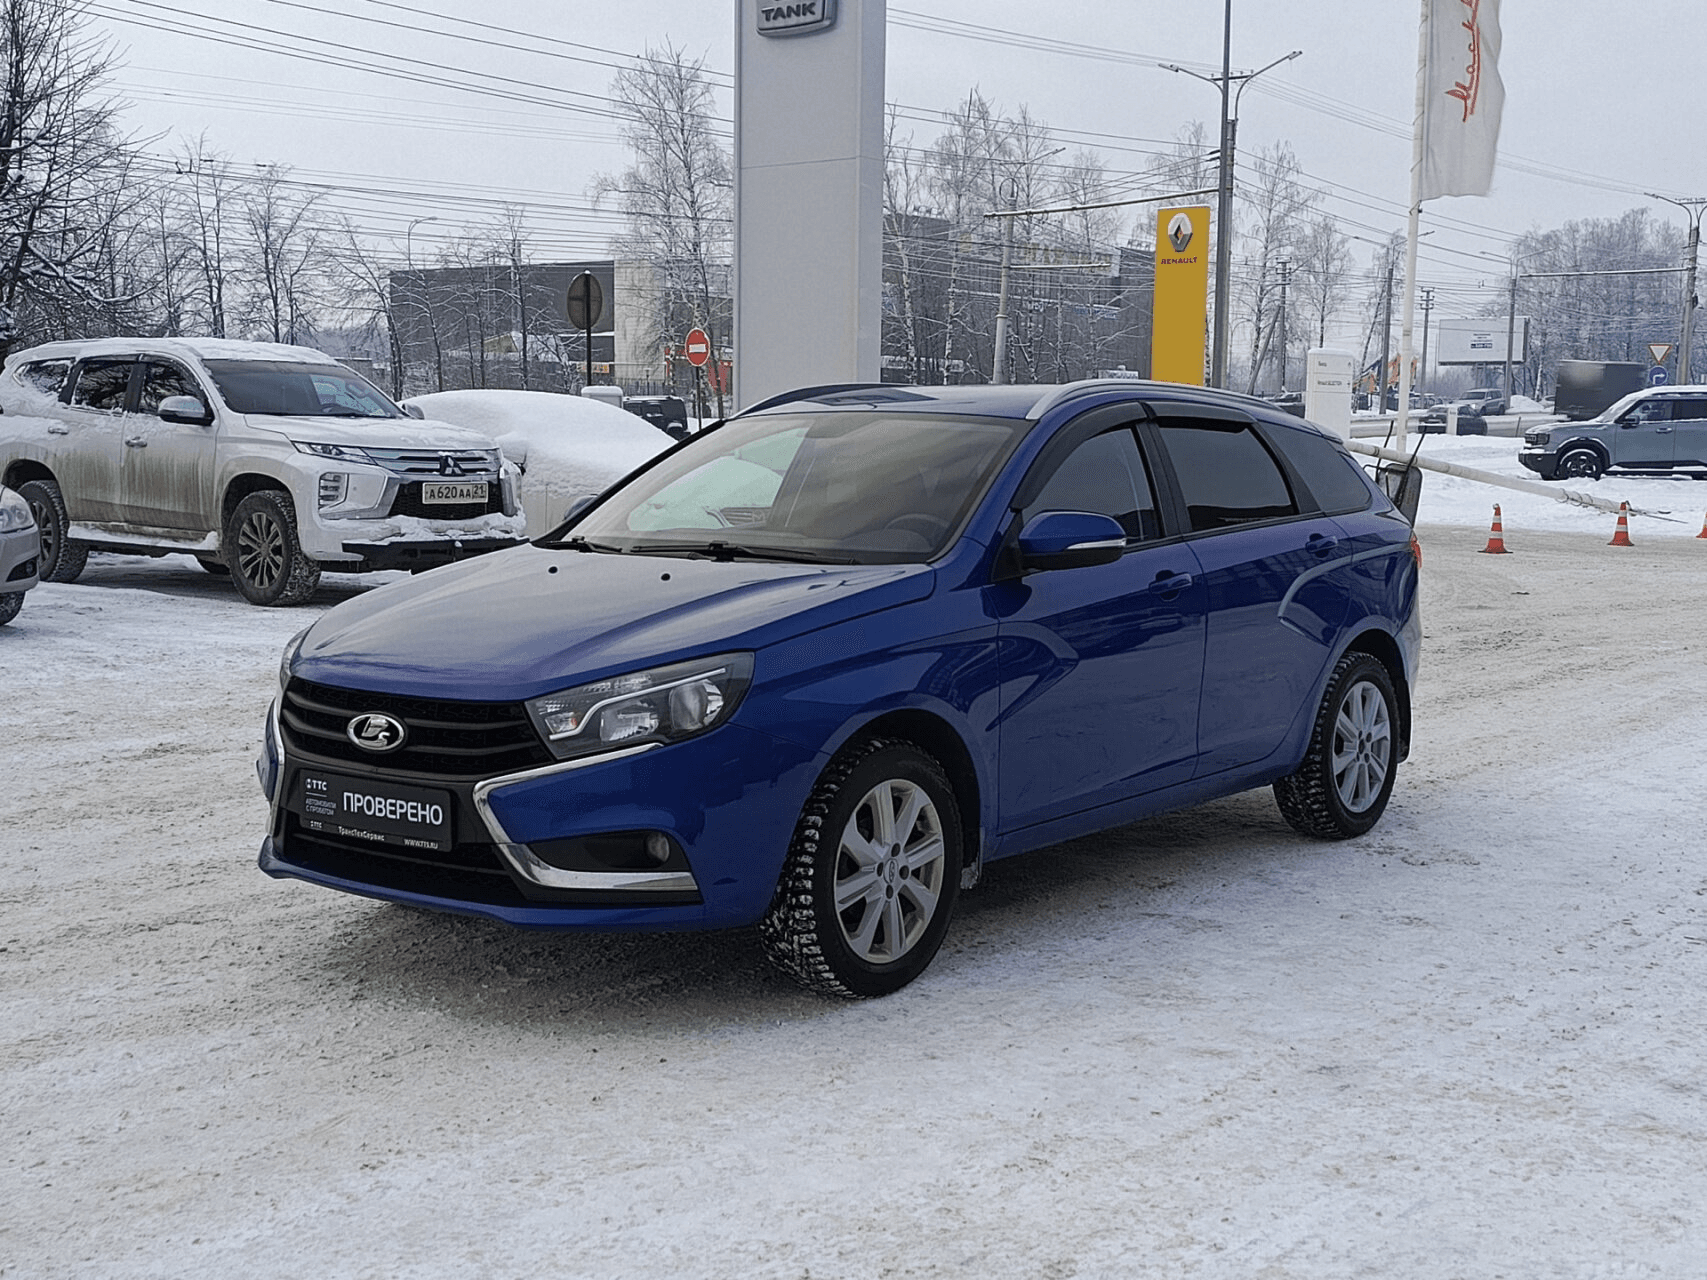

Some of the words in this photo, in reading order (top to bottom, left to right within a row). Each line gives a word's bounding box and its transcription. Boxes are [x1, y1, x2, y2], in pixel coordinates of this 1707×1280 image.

[761, 2, 816, 22] TANK
[1160, 256, 1198, 265] RENAULT
[343, 791, 443, 826] ПРОВЕРЕНО
